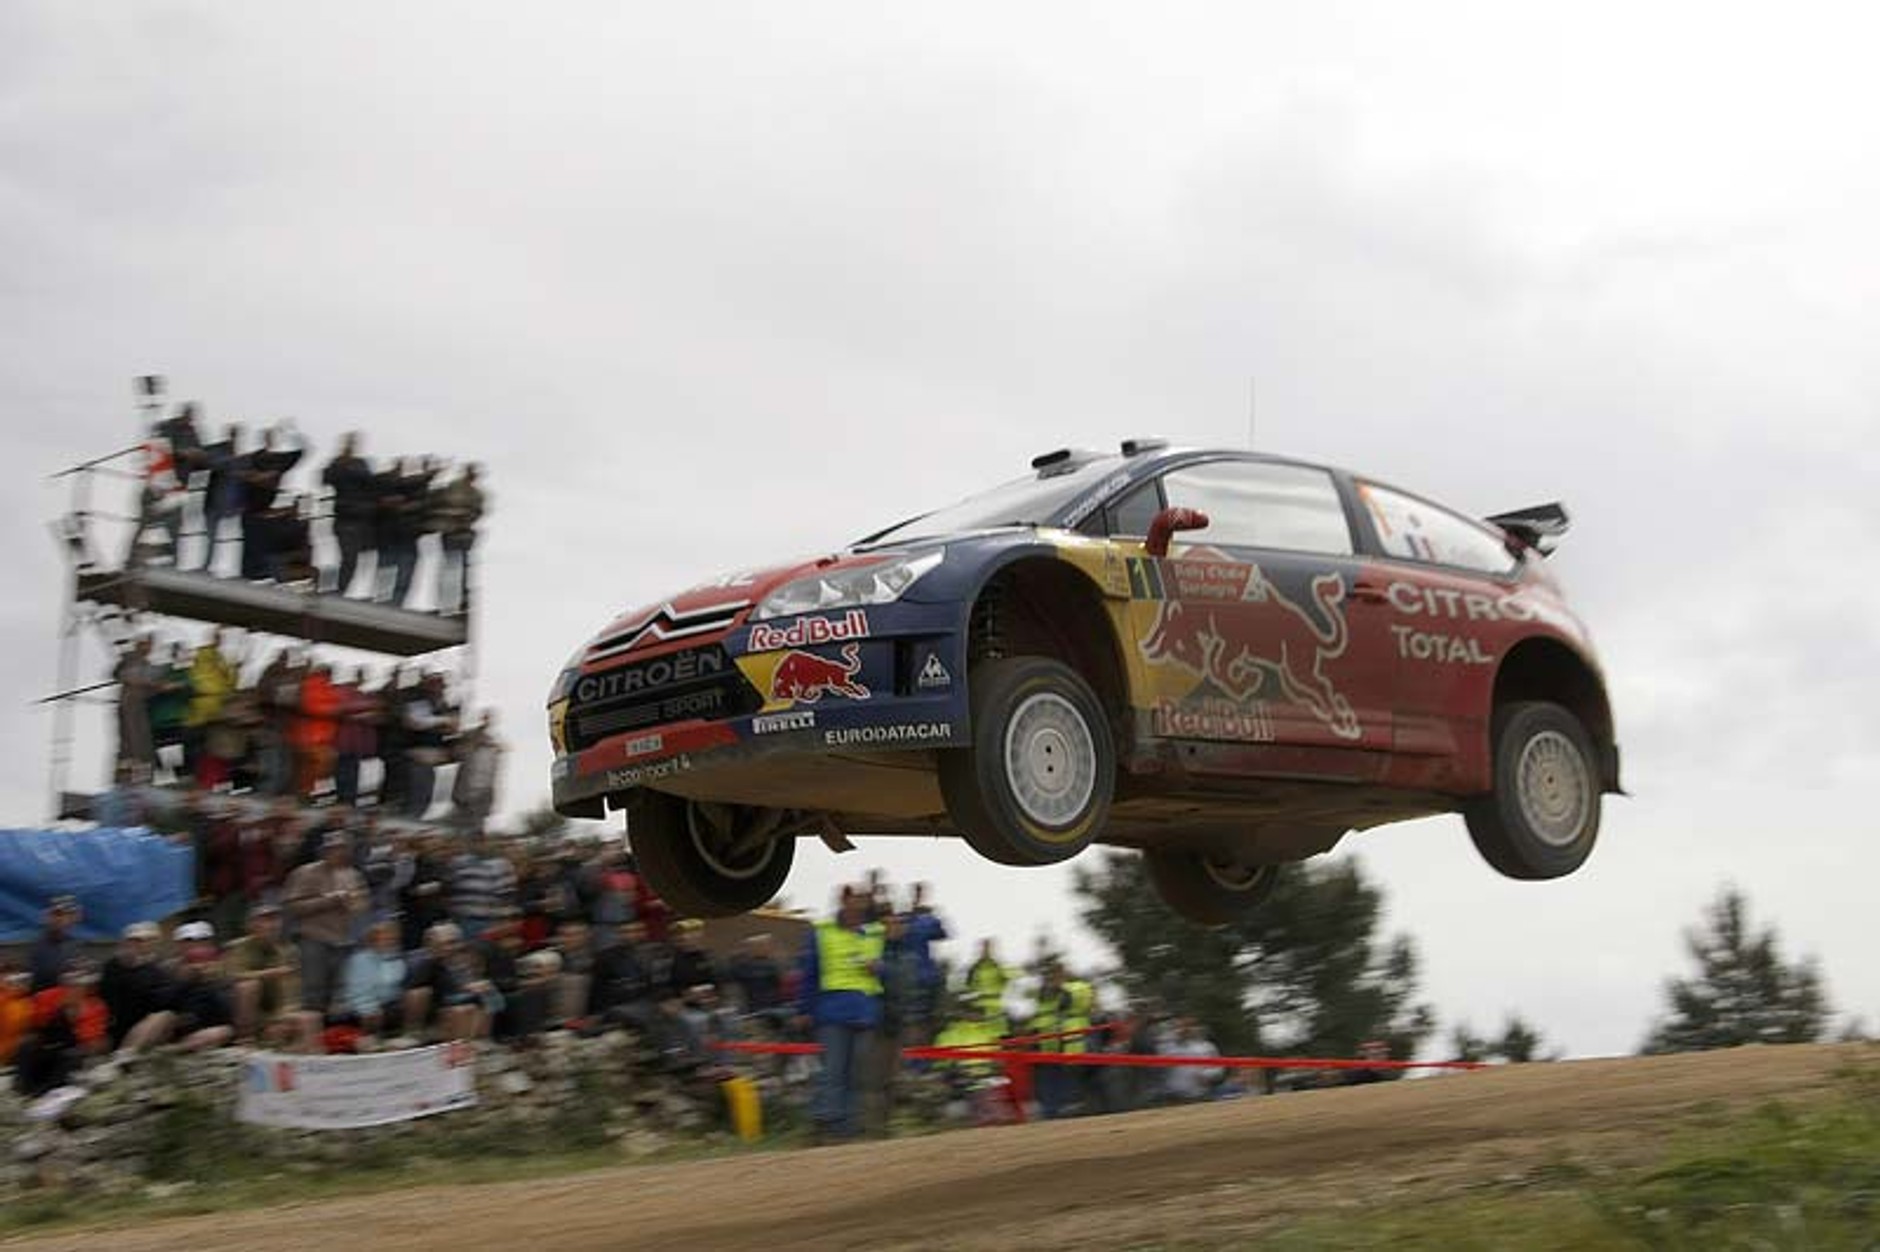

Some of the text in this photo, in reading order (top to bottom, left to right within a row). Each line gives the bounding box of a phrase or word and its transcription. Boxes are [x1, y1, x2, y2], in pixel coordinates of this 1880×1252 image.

[1388, 581, 1538, 621] CITRO
[748, 609, 870, 651] Red Bull
[577, 649, 722, 702] CITROËN
[753, 711, 815, 734] PIRELLI
[825, 724, 951, 744] EURODATACAR
[1157, 696, 1275, 741] Red Bull
